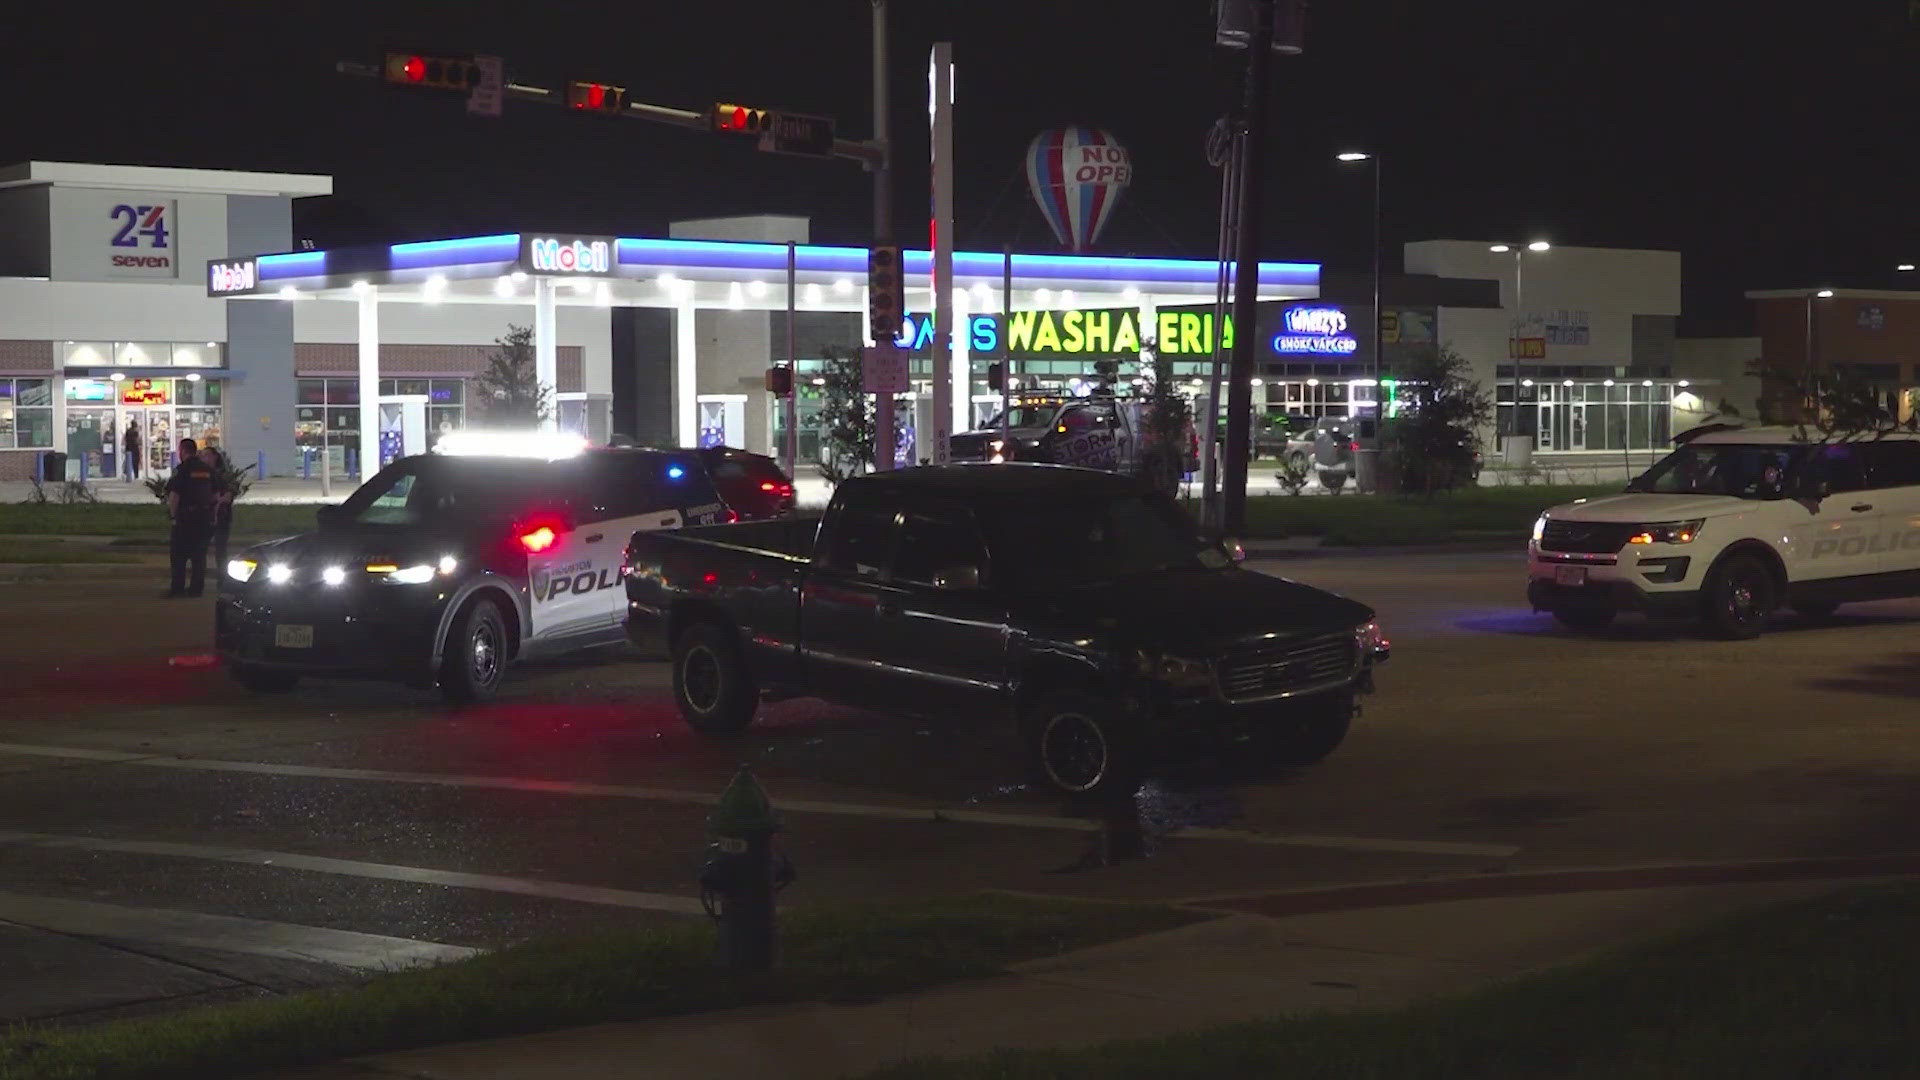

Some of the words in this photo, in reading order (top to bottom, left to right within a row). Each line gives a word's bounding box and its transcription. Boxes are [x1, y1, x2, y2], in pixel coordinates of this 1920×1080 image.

[112, 255, 169, 267] seven
[532, 239, 608, 272] Mobil
[212, 261, 254, 291] Mobil
